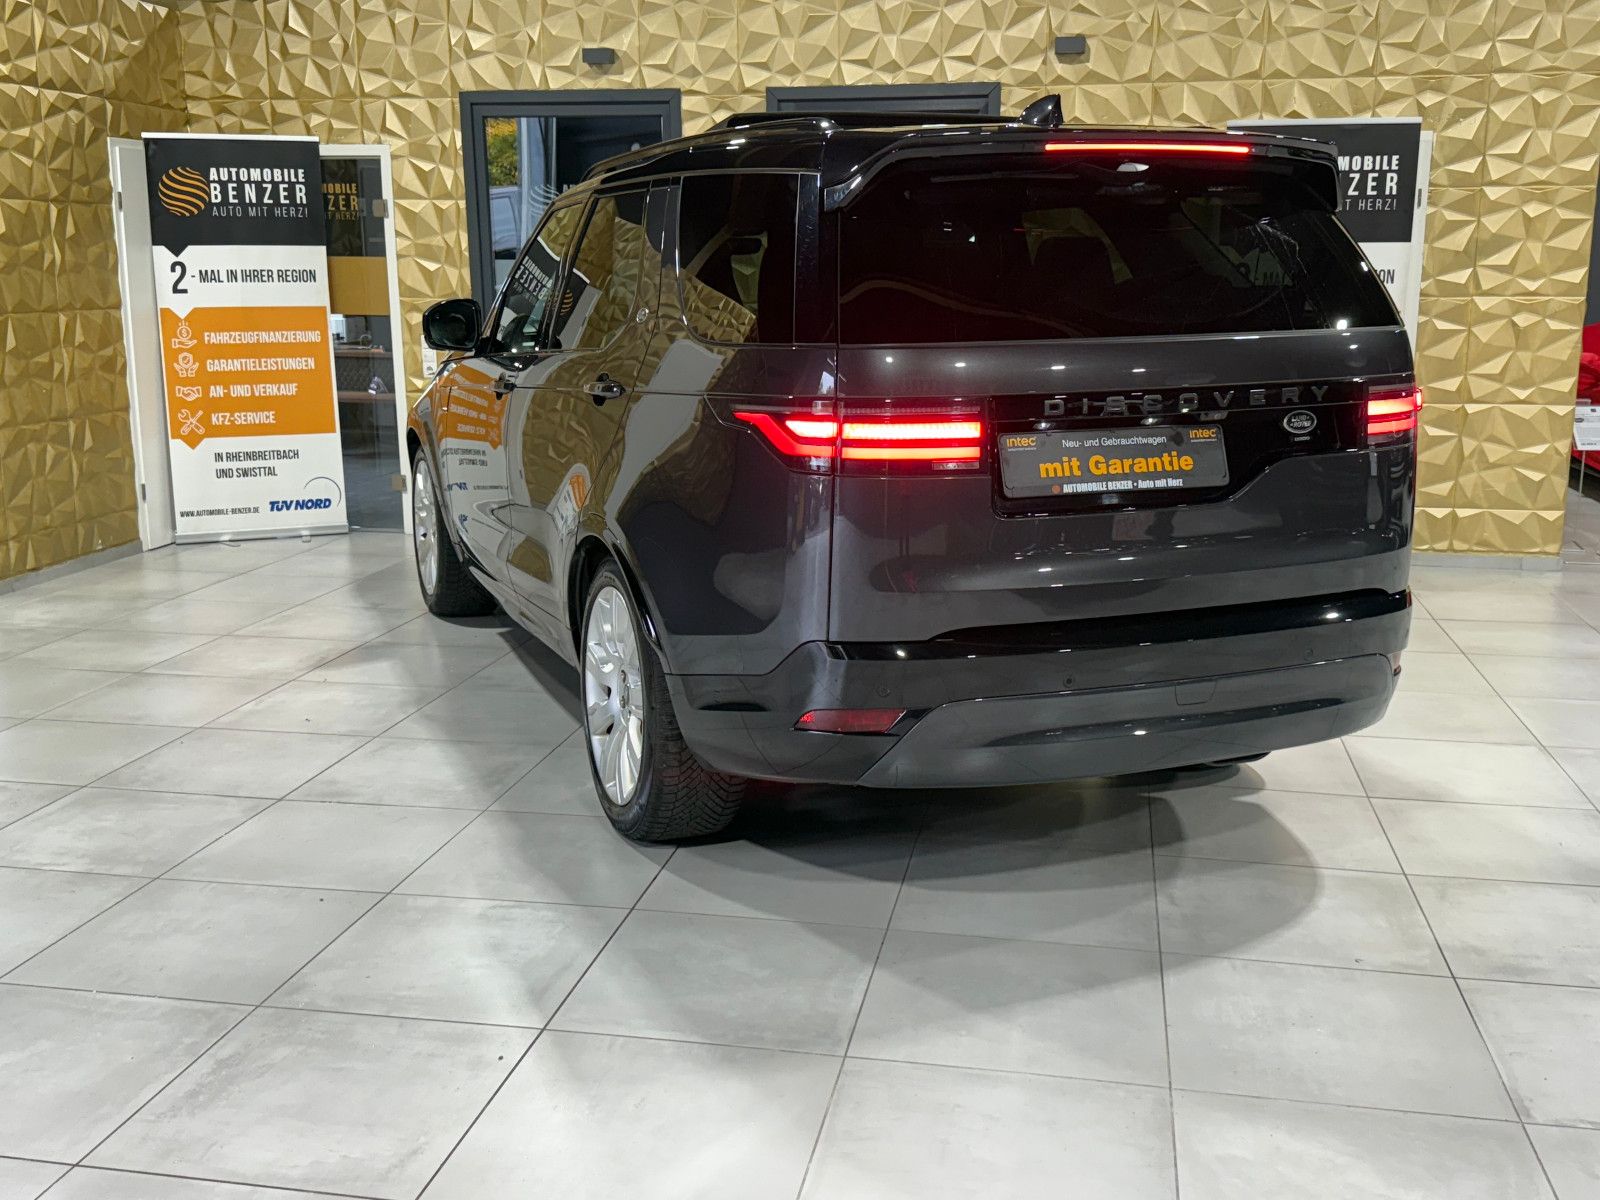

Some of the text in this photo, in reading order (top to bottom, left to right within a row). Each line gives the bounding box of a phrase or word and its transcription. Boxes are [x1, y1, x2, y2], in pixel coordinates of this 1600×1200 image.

[1337, 155, 1399, 171] MOBILE
[209, 167, 305, 182] AUTOMOBILE
[1347, 172, 1398, 195] ZER
[209, 183, 307, 204] BENZER
[327, 195, 359, 211] ZER
[1358, 198, 1396, 210] HERZ!
[212, 206, 308, 218] AUTO MIT HERZ!
[199, 269, 224, 283] MAL
[226, 269, 238, 283] IN
[241, 269, 274, 283] IHRER
[277, 269, 317, 283] REGION
[204, 330, 321, 344] FAHRZEUGFINANZIERUNG
[206, 357, 315, 372] GARANTIELEISTUNGEN
[209, 383, 298, 398] AN- UND VERKAUF
[1044, 386, 1329, 416] DISCOVERY
[211, 411, 276, 425] KFZ-SERVICE
[1007, 437, 1037, 447] intec
[1062, 435, 1167, 448] Neu- und Gebrauchtwagen
[214, 449, 300, 463] IN RHEINBREITBACH
[1039, 450, 1194, 478] mit Garantie
[215, 466, 278, 479] UND SWISTTAL
[1063, 477, 1183, 493] AUTOMOBILE BENZER Auto mit Herz
[179, 506, 260, 518] WWW.AUTOMOBILE-BENZER.DE
[269, 498, 332, 512] TÜV NORD
